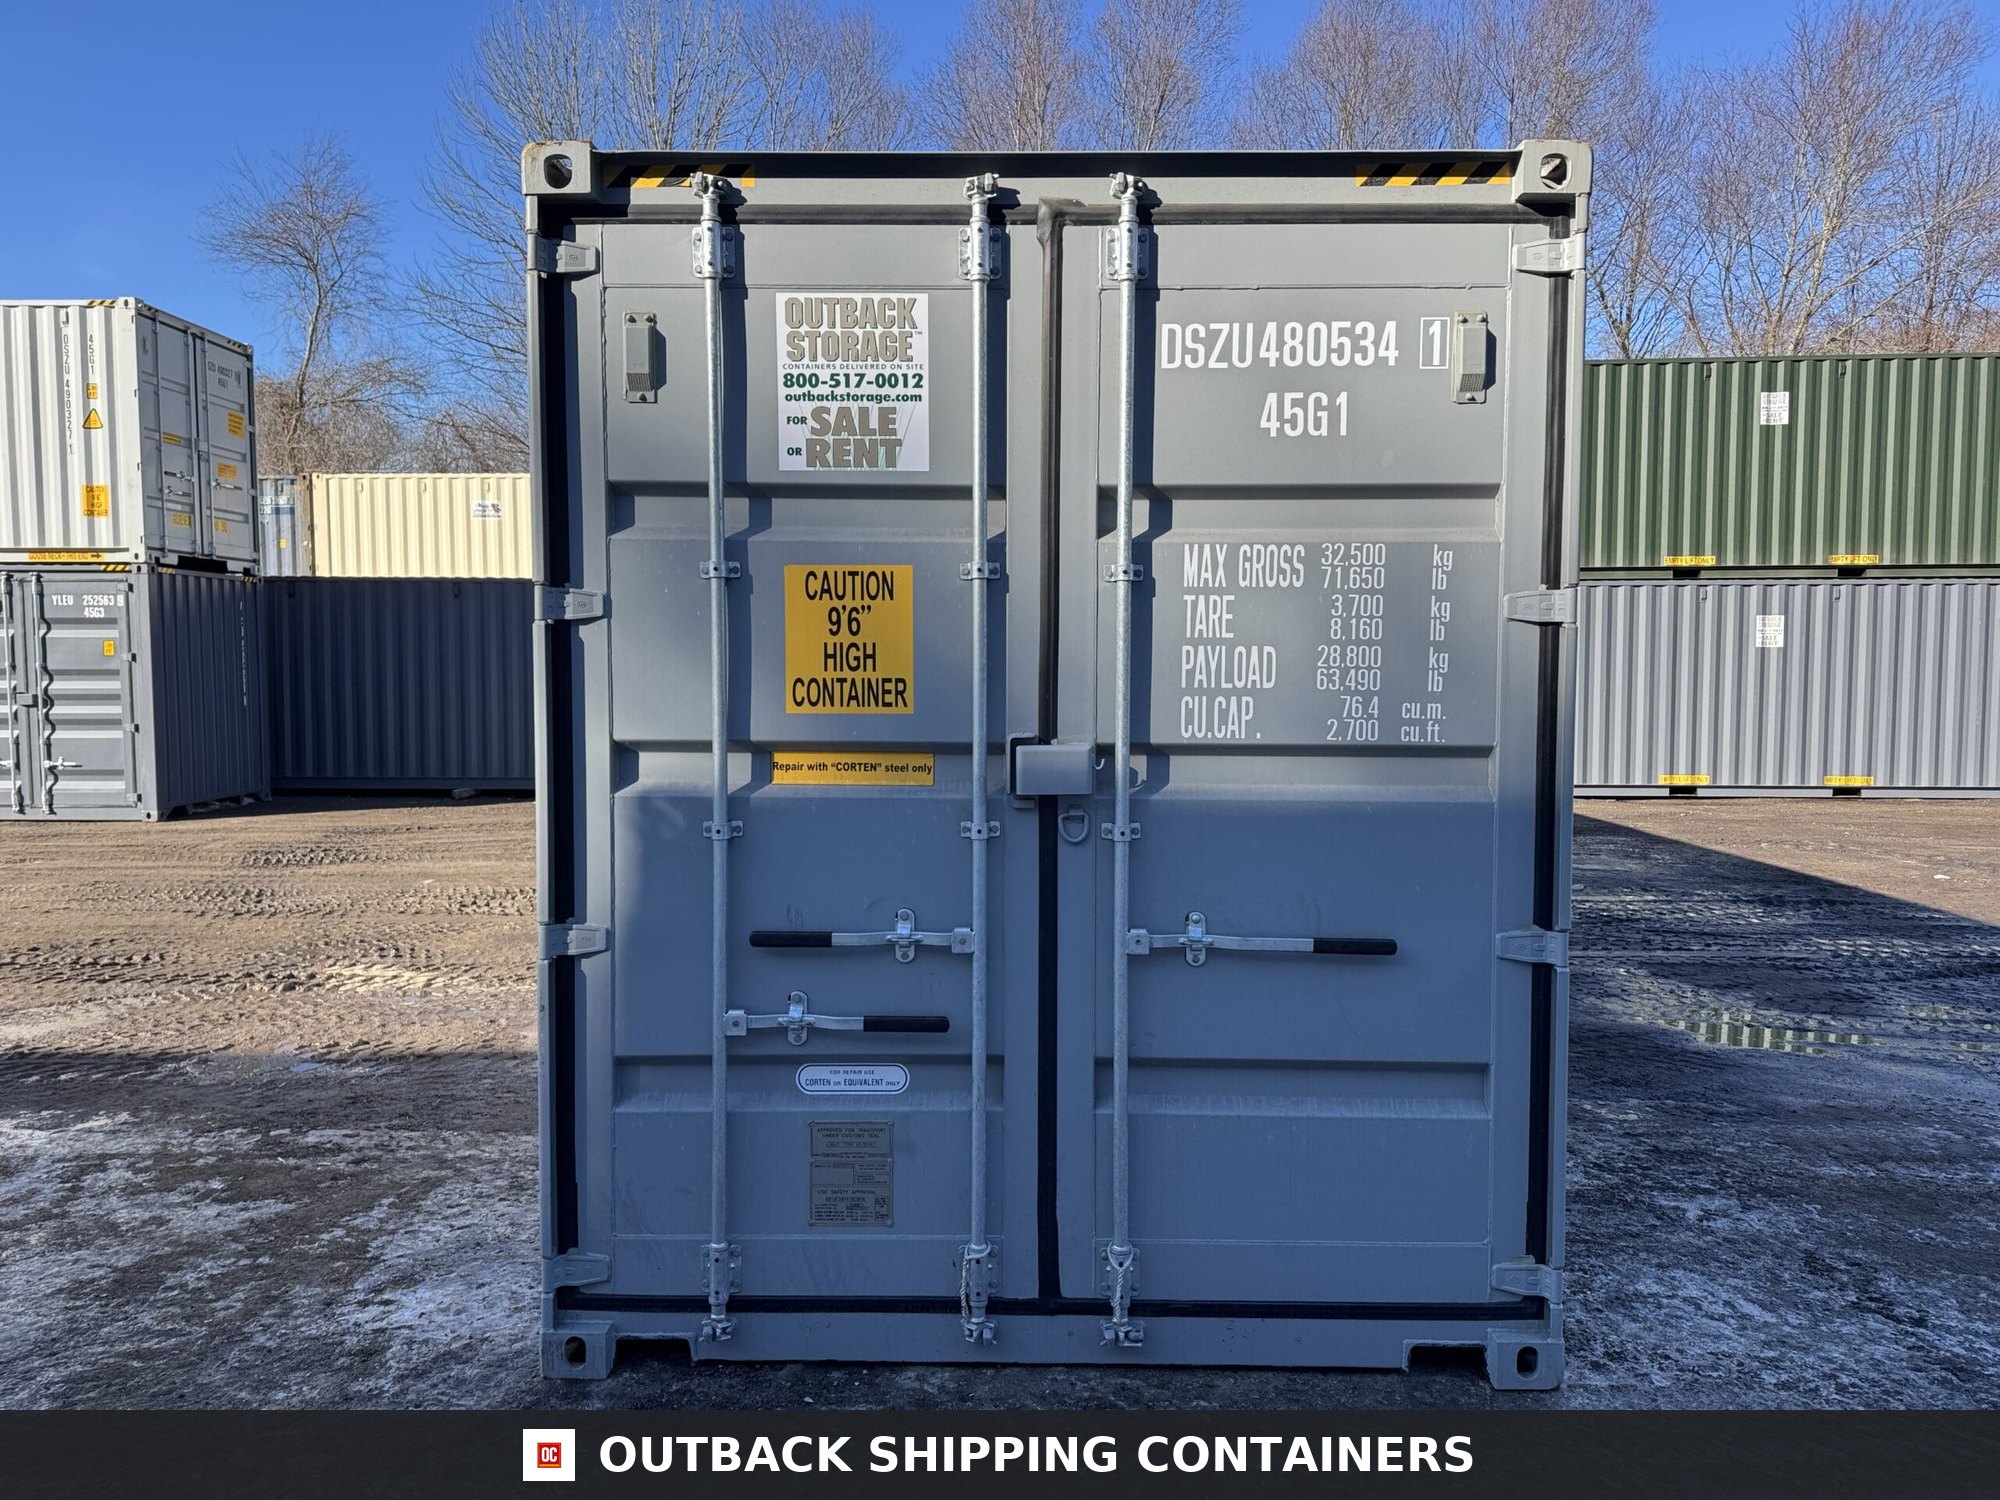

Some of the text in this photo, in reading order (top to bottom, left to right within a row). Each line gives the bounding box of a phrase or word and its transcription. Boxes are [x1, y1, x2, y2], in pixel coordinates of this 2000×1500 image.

[784, 297, 918, 329] OUTBACK
[786, 331, 913, 362] STORAGE
[1428, 320, 1441, 365] 1
[783, 373, 923, 389] 800-517-0012
[784, 390, 922, 404] outbackstorage.com
[786, 406, 897, 437] FOR SALE
[1260, 391, 1348, 437] 45G1
[787, 438, 902, 468] OR RENT
[1183, 543, 1453, 588] MAX GROSS 32,500 kg
[1321, 566, 1447, 590] 71,650 lb
[52, 595, 73, 605] YLEU
[82, 595, 114, 605] 252563
[805, 570, 894, 601] CAUTION
[1183, 594, 1451, 638] TARE 3,700 kg
[1330, 617, 1445, 641] 8,160 lb
[823, 641, 876, 672] HIGH
[1181, 645, 1449, 689] PAYLOAD 28,800 kg
[792, 677, 908, 708] CONTAINER
[1316, 668, 1443, 692] 63,490 lb
[1340, 696, 1379, 719] 76.4
[1401, 702, 1446, 719] cu.m.
[1326, 719, 1446, 743] 2,700 cu.ft.
[773, 761, 803, 773] Repair
[807, 761, 828, 772] with
[885, 763, 909, 773] steel
[912, 762, 933, 776] only
[805, 1078, 831, 1086] CORTEN
[844, 1078, 884, 1086] EQUIVALENT
